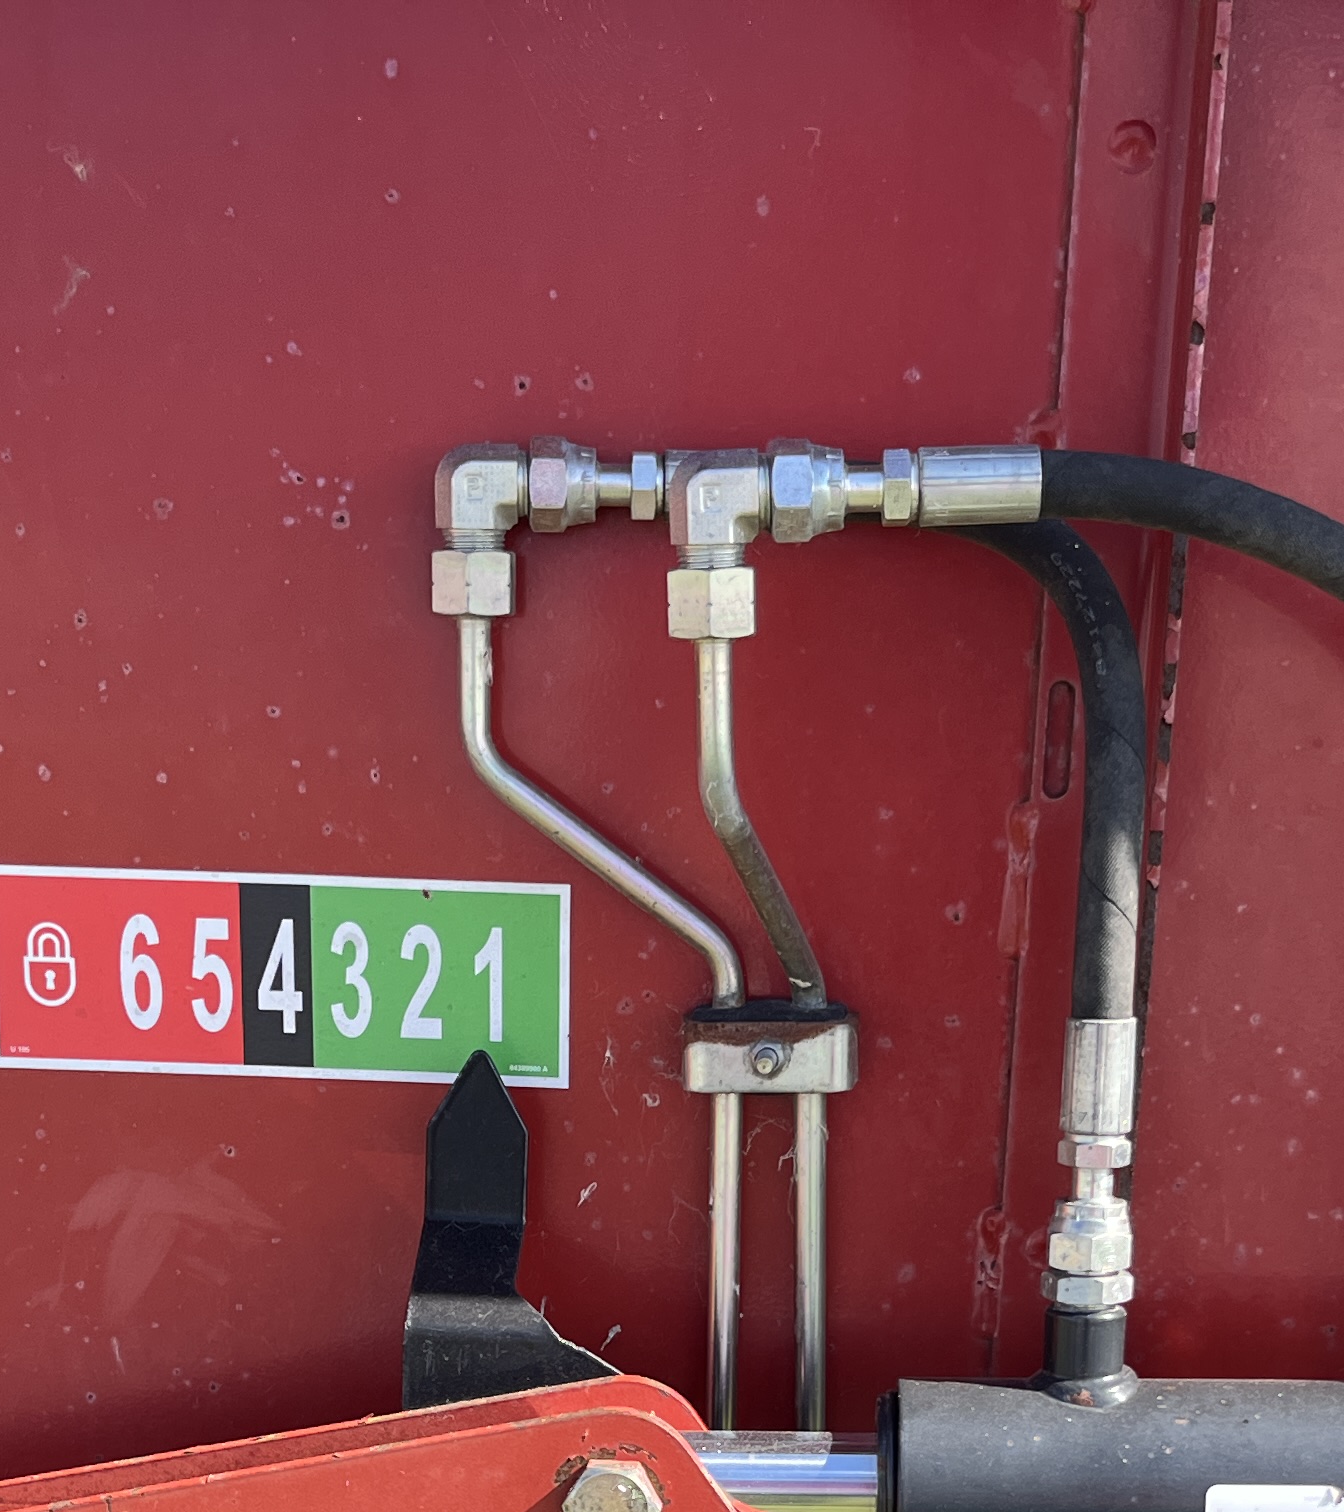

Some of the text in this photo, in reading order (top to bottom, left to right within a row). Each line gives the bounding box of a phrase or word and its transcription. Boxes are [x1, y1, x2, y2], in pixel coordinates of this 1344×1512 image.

[120, 913, 503, 1042] 6 5 4 3 2 1
